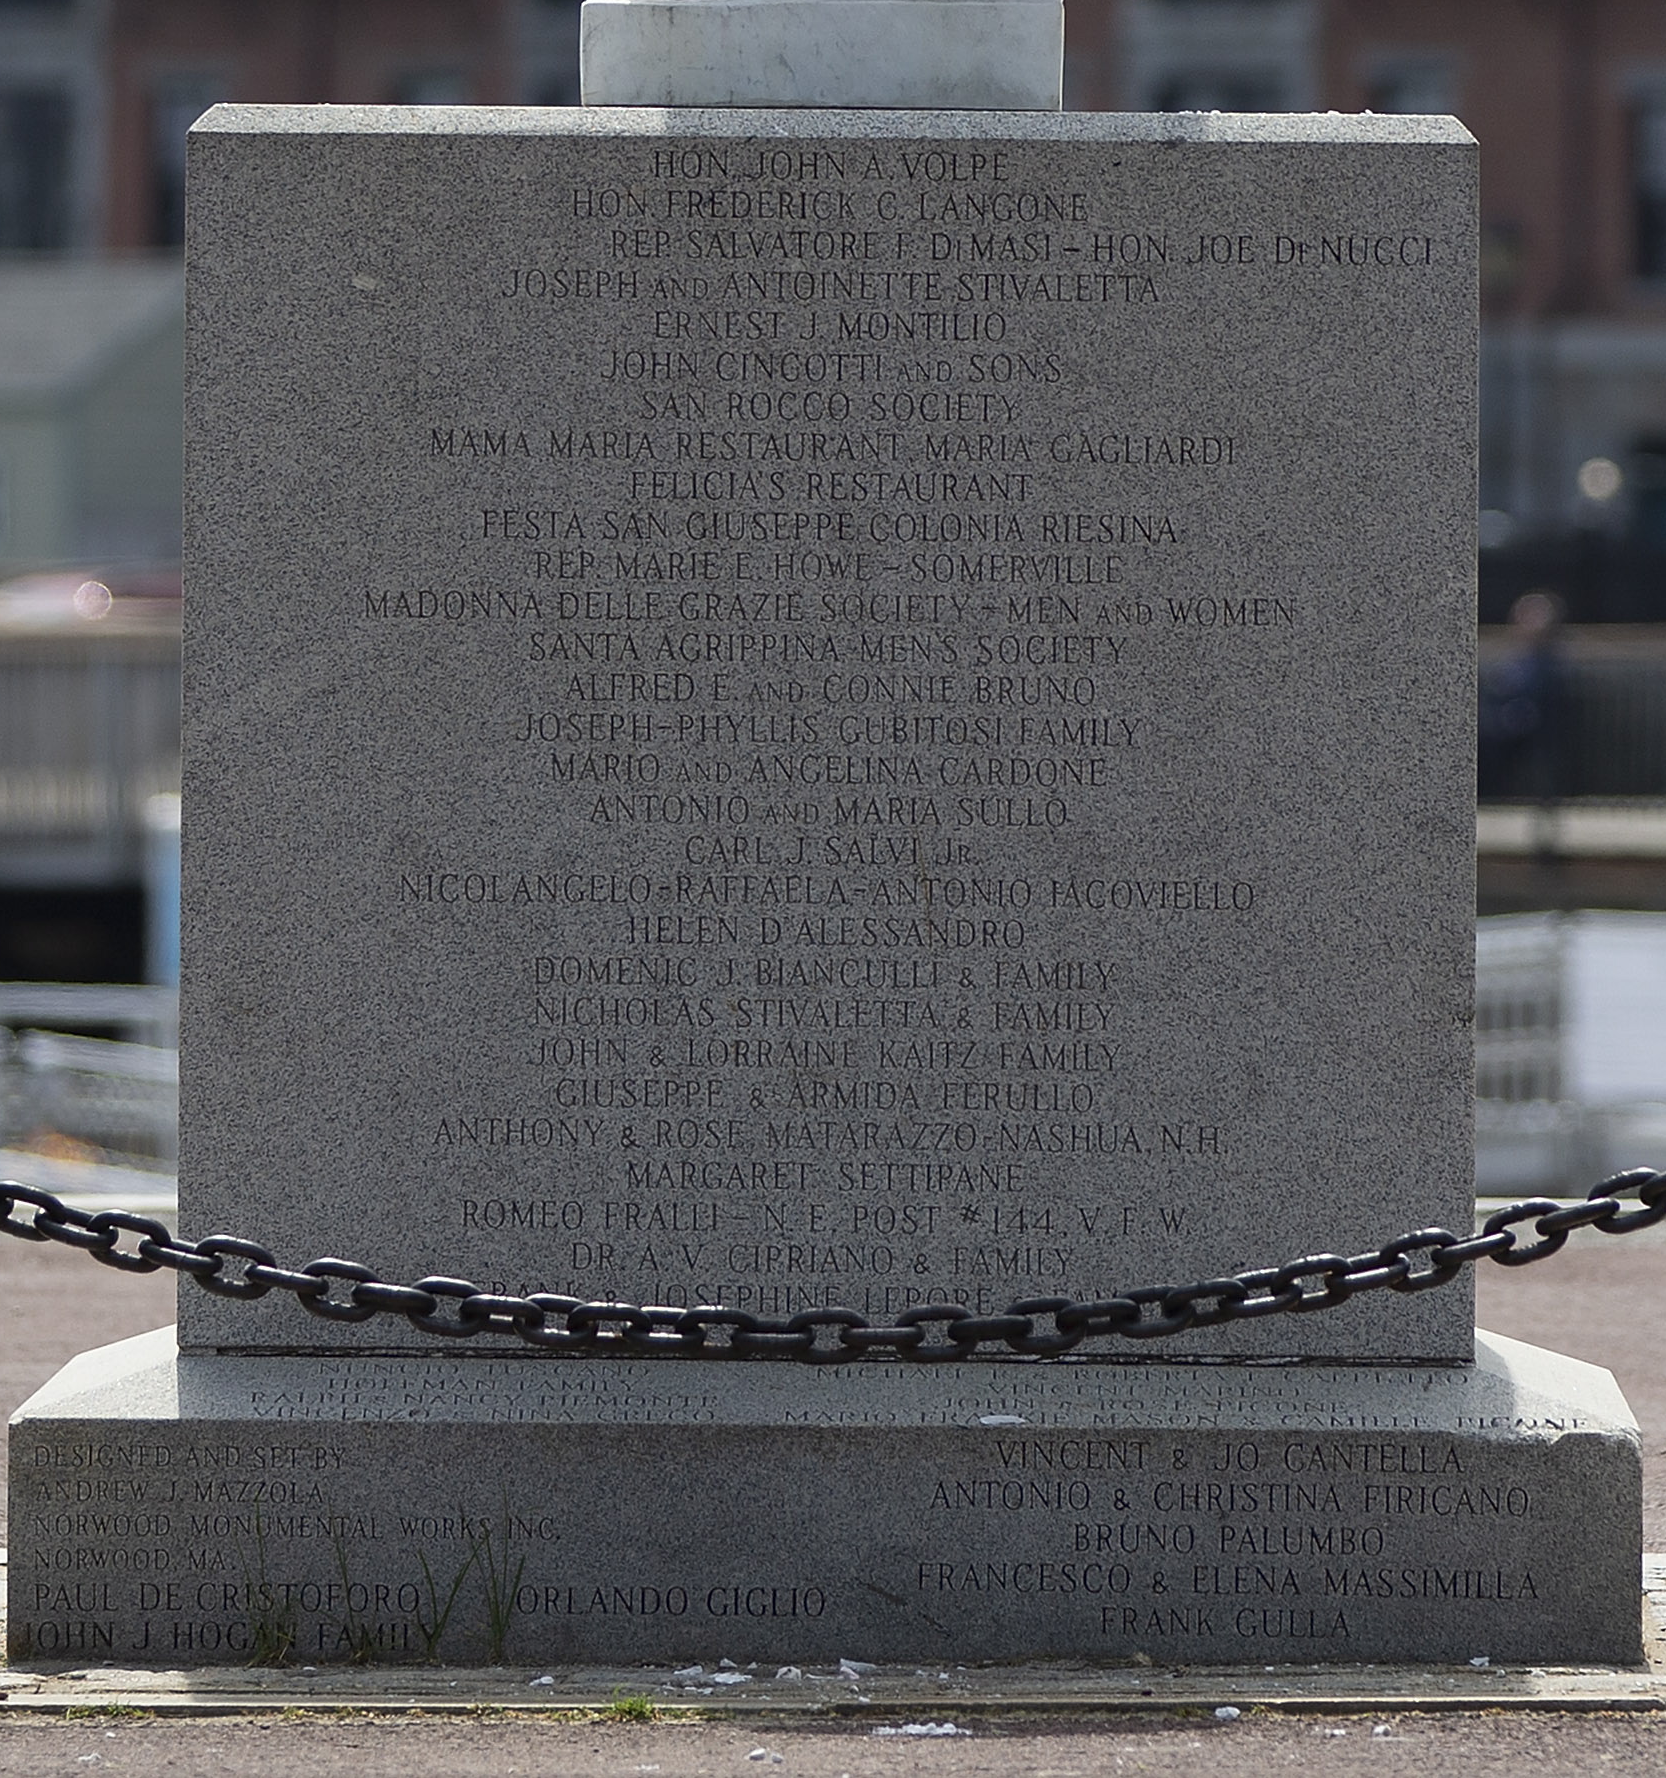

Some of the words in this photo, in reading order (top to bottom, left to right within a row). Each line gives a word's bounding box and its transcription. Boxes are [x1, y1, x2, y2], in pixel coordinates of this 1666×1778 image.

[742, 152, 846, 181] JOHN
[902, 152, 1010, 181] VOLPE
[572, 189, 656, 218] HON.
[667, 191, 854, 220] FREDERICK
[877, 193, 904, 221] C.
[920, 193, 1087, 223] LANGONE
[502, 269, 637, 299] JOSEPH
[723, 271, 942, 301] ANTOINETTE
[957, 273, 1159, 303] STIVALETTA
[654, 311, 782, 341] ERNEST
[838, 312, 1007, 342] MONTILIO
[600, 352, 698, 381] JOHN
[716, 352, 882, 382] CINCOTTI
[968, 355, 1063, 383] SONS
[642, 391, 706, 421] SAN
[731, 392, 850, 422] ROCCO
[871, 393, 1020, 423] SOCIETY
[433, 429, 531, 460] MAMA
[550, 430, 655, 461] MARIA
[925, 433, 1032, 463] MARIA
[1049, 434, 1236, 465] GAGLIARDI
[633, 471, 785, 501] FELICIA'S
[807, 473, 1033, 503] RESTAURANT
[482, 510, 583, 539] FESTA
[603, 511, 670, 541] SAN
[686, 511, 854, 541] GIUSEPPE
[869, 514, 1025, 544] COLONIA
[1041, 514, 1178, 544] RIESINA
[535, 552, 600, 580] REP.
[615, 553, 719, 580] MARIE
[736, 554, 762, 581] E.
[774, 554, 873, 582] HOWE
[912, 555, 1123, 584] SOMERVILLE
[364, 591, 542, 620] MADONNA
[559, 592, 658, 621] DELLE
[678, 592, 804, 622] GRAZIE
[821, 594, 969, 623] SOCIETY
[1008, 596, 1080, 625] MEN
[1167, 598, 1295, 627] WOMEN
[529, 633, 639, 663] SANTA
[655, 633, 840, 663] AGRIPPINA
[976, 636, 1129, 665] SOCIETY
[567, 673, 694, 702] ALFRED
[823, 674, 956, 704] CONNIE
[976, 676, 1097, 705] BRUNO
[838, 716, 1003, 746] GUBITOSI
[1020, 717, 1142, 747] FAMILY
[550, 754, 660, 784] MARIO
[748, 755, 922, 785] ANGELINA
[940, 757, 1107, 787] CARDONE
[589, 795, 750, 824] ANTONIO
[834, 796, 941, 826] MARIA
[957, 797, 1069, 827] SULLO
[685, 835, 770, 865] CARL
[785, 836, 811, 866] J.
[824, 836, 920, 866] SALVI
[632, 916, 738, 945] HELEN
[535, 955, 699, 986] DOMENIC
[756, 958, 938, 989] BIANCULLI
[960, 966, 975, 988] &
[994, 960, 1118, 991] FAMILY
[535, 997, 715, 1026] NICHOLAS
[735, 999, 940, 1029] STIVALETTA
[956, 1007, 972, 1029] &
[994, 1001, 1116, 1032] FAMILY
[534, 1040, 627, 1067] JOHN
[649, 1046, 666, 1068] &
[686, 1040, 858, 1068] LORRAINE
[879, 1041, 977, 1070] KAITZ
[999, 1042, 1122, 1073] FAMILY
[555, 1079, 723, 1108] GIUSEPPE
[749, 1088, 765, 1109] &
[788, 1082, 920, 1110] ARMIDA
[942, 1082, 1095, 1112] FERULLO
[434, 1118, 605, 1147] ANTHONY
[619, 1126, 637, 1149] &
[655, 1119, 746, 1149] ROSE
[627, 1161, 814, 1190] MARGARET
[838, 1162, 1025, 1193] SETTIPANE
[34, 1444, 172, 1469] DESIGNED
[177, 1446, 239, 1469] AND
[253, 1446, 297, 1470] SET
[315, 1447, 346, 1470] BY
[997, 1441, 1149, 1470] VINCENT
[1172, 1447, 1189, 1470] &
[1213, 1443, 1259, 1472] JO
[1285, 1443, 1465, 1474] CANTELLA
[36, 1481, 145, 1503] ANDREW
[194, 1481, 325, 1504] MAZZOLA
[930, 1481, 1091, 1510] ANTONIO
[1113, 1488, 1131, 1511] &
[1153, 1482, 1343, 1514] CHRISTINA
[1364, 1485, 1530, 1517] FIRICANO
[34, 1515, 172, 1538] NORWOOD
[189, 1515, 383, 1539] MONUMENTAL
[399, 1517, 490, 1540] WORKS
[508, 1517, 562, 1541] INC.
[1074, 1524, 1195, 1553] BRUNO
[1220, 1526, 1384, 1556] PALUMBO
[33, 1582, 119, 1612] PAUL
[139, 1582, 182, 1612] DE
[197, 1583, 420, 1613] CRISTOFORO
[918, 1563, 1131, 1594] FRANCESCO
[1151, 1571, 1169, 1594] &
[1192, 1566, 1302, 1596] ELENA
[1323, 1568, 1540, 1600] MASSIMILLA
[515, 1587, 689, 1615] ORLANDO
[705, 1588, 828, 1617] GIGLIO
[21, 1622, 113, 1650] JOHN
[1100, 1606, 1214, 1636] FRANK
[1235, 1608, 1352, 1638] GULLA
